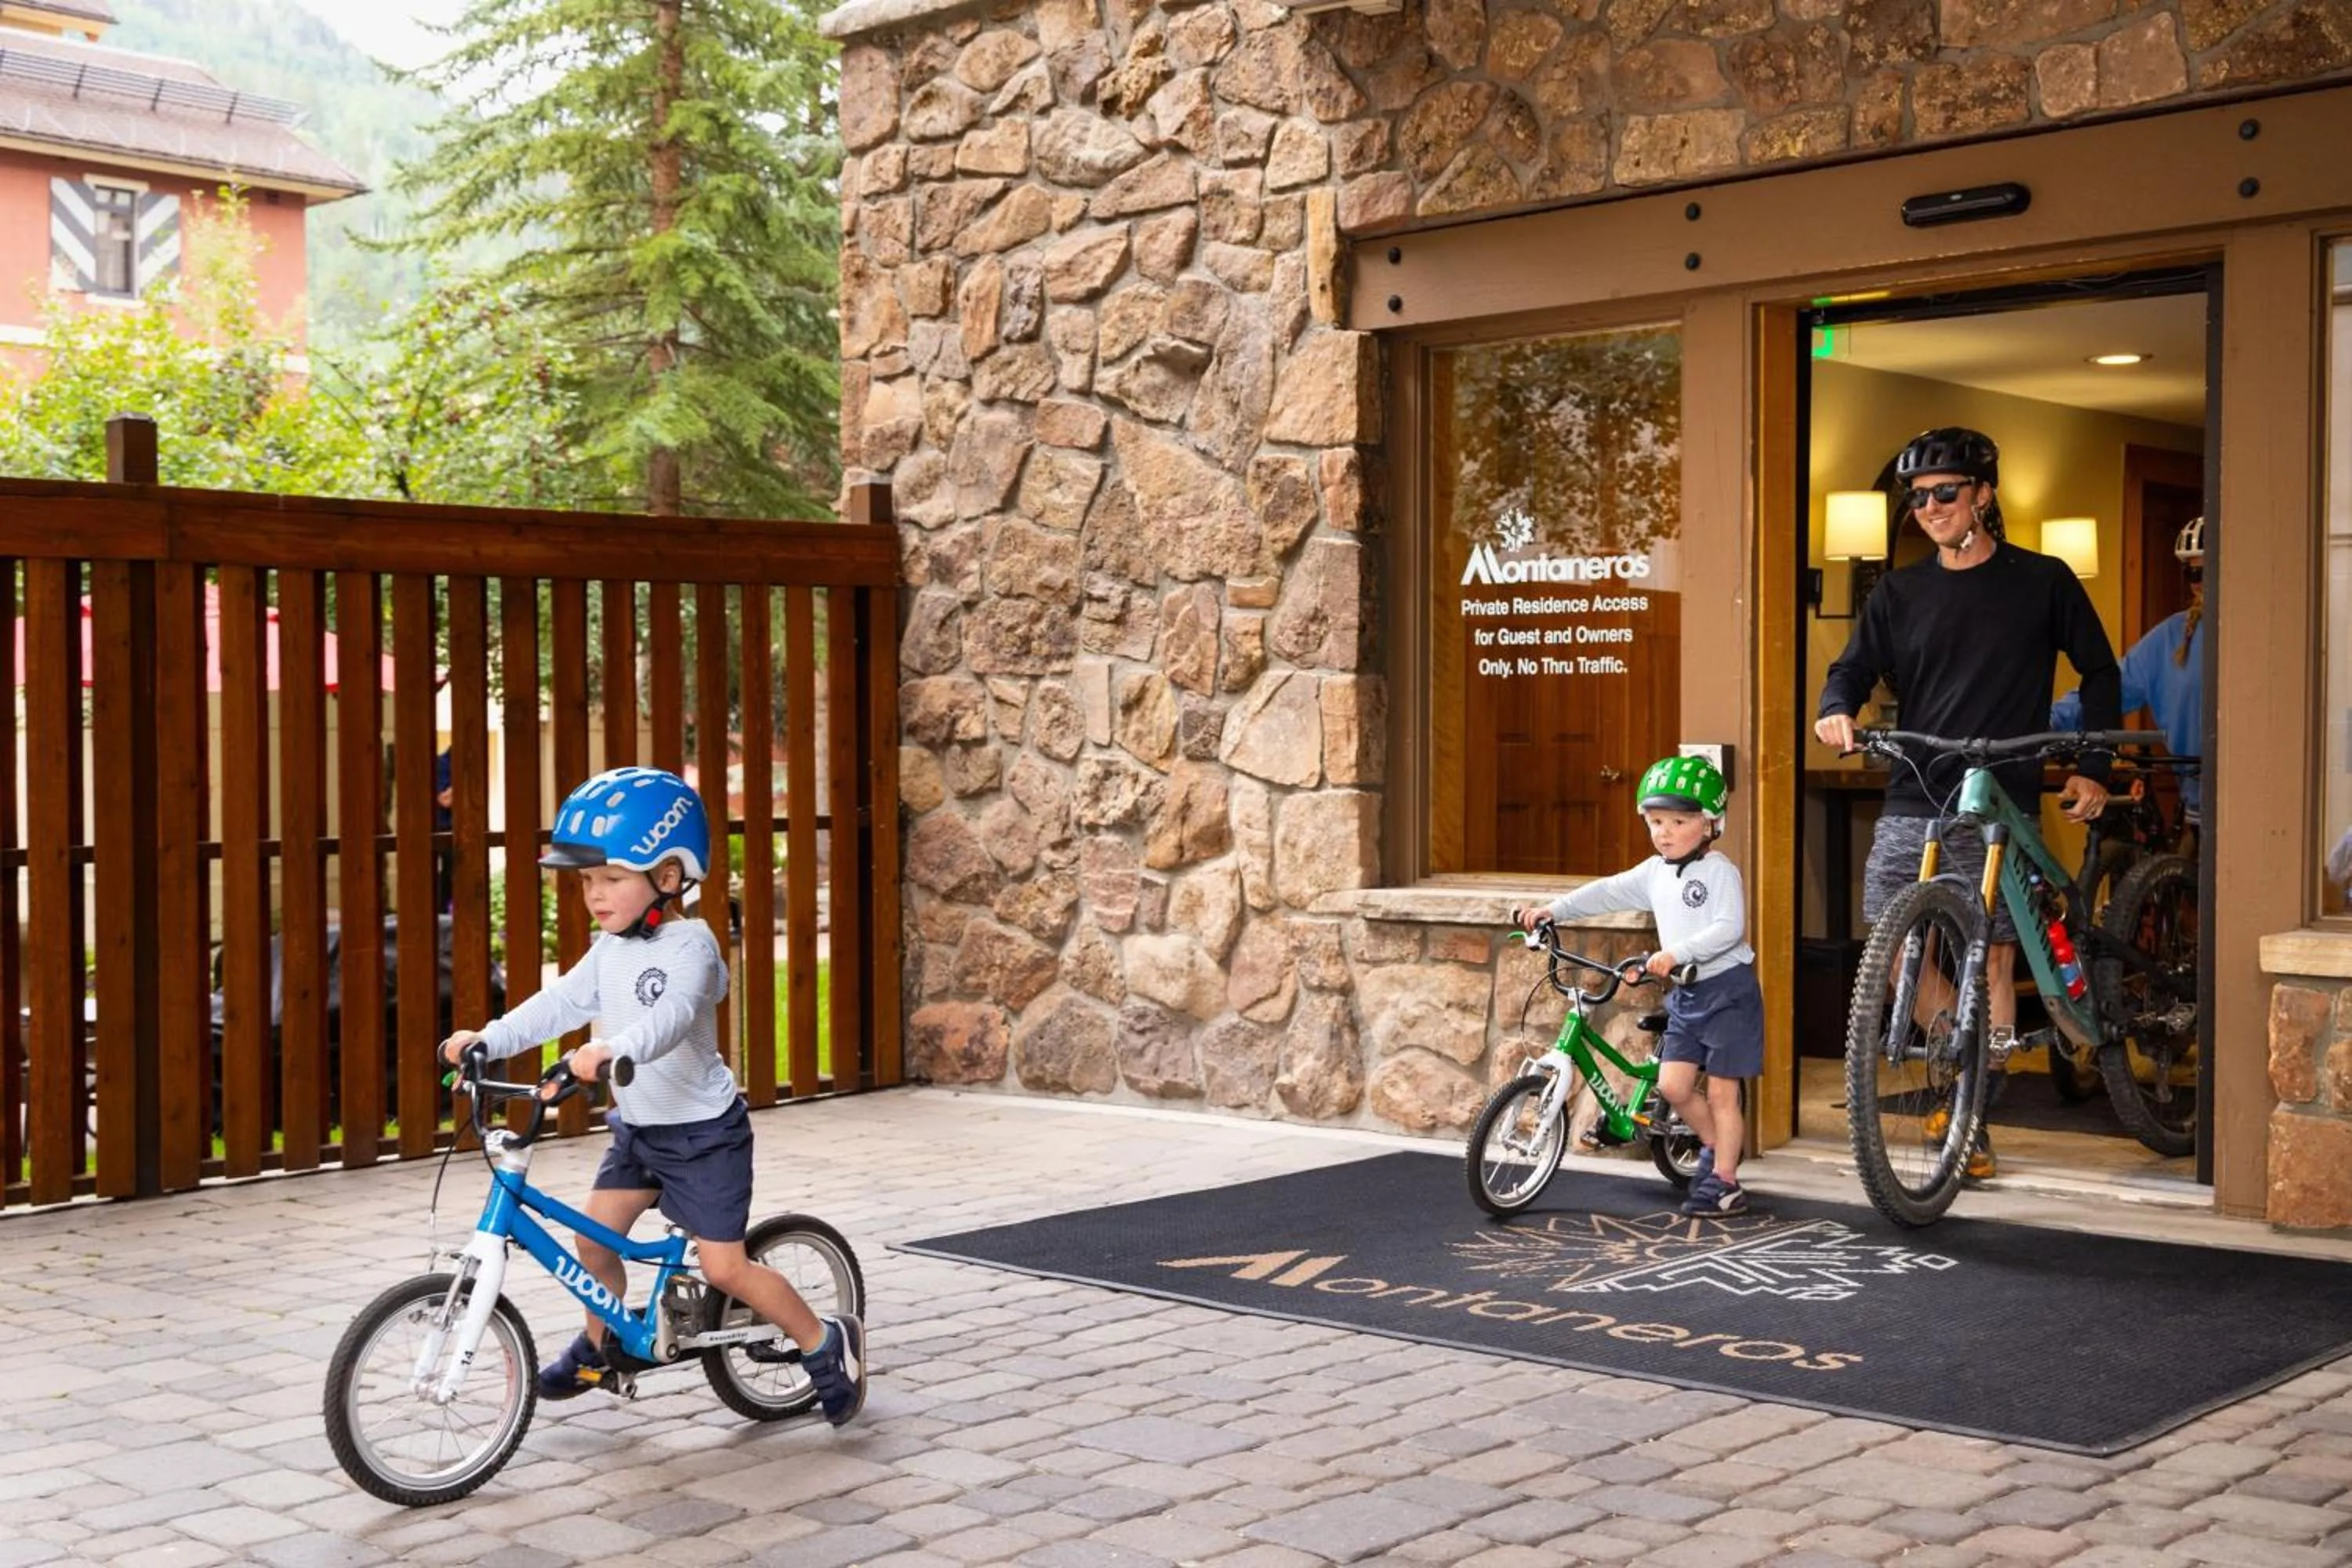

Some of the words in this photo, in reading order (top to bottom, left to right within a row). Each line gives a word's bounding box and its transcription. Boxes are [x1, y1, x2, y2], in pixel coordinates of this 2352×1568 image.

[1461, 543, 1650, 585] Montaneros
[1461, 597, 1509, 616] Private
[1512, 596, 1589, 614] Residence
[1592, 594, 1649, 612] Access
[1474, 629, 1495, 646] for
[1497, 627, 1541, 645] Guest
[1544, 626, 1572, 644] and
[1575, 626, 1633, 644] Owners
[1478, 658, 1514, 679] Only.
[1516, 658, 1538, 675] No
[1541, 657, 1573, 674] Thru
[1578, 656, 1628, 674] Traffic.
[630, 797, 693, 855] woom
[554, 1255, 632, 1323] woom
[1156, 1250, 1864, 1370] Montaneros
